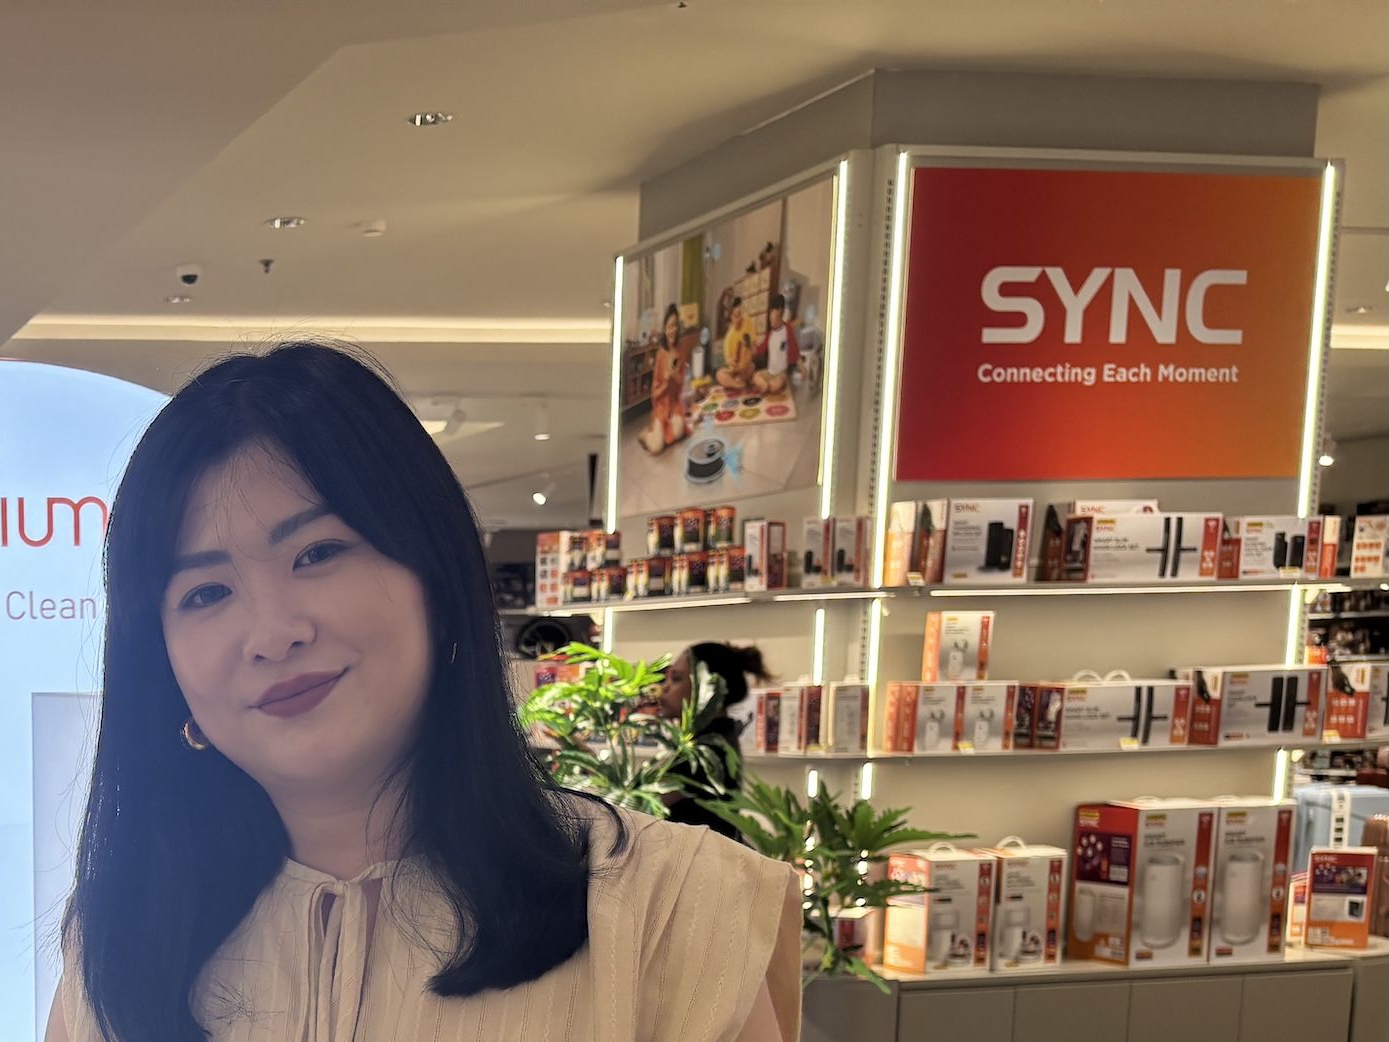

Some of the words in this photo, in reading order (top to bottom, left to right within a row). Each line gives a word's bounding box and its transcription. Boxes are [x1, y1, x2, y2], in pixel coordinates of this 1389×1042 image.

[980, 266, 1247, 344] SYNC
[977, 363, 1097, 386] Connecting
[1103, 363, 1151, 383] Each
[1158, 363, 1239, 383] Moment
[6, 590, 97, 620] Clean
